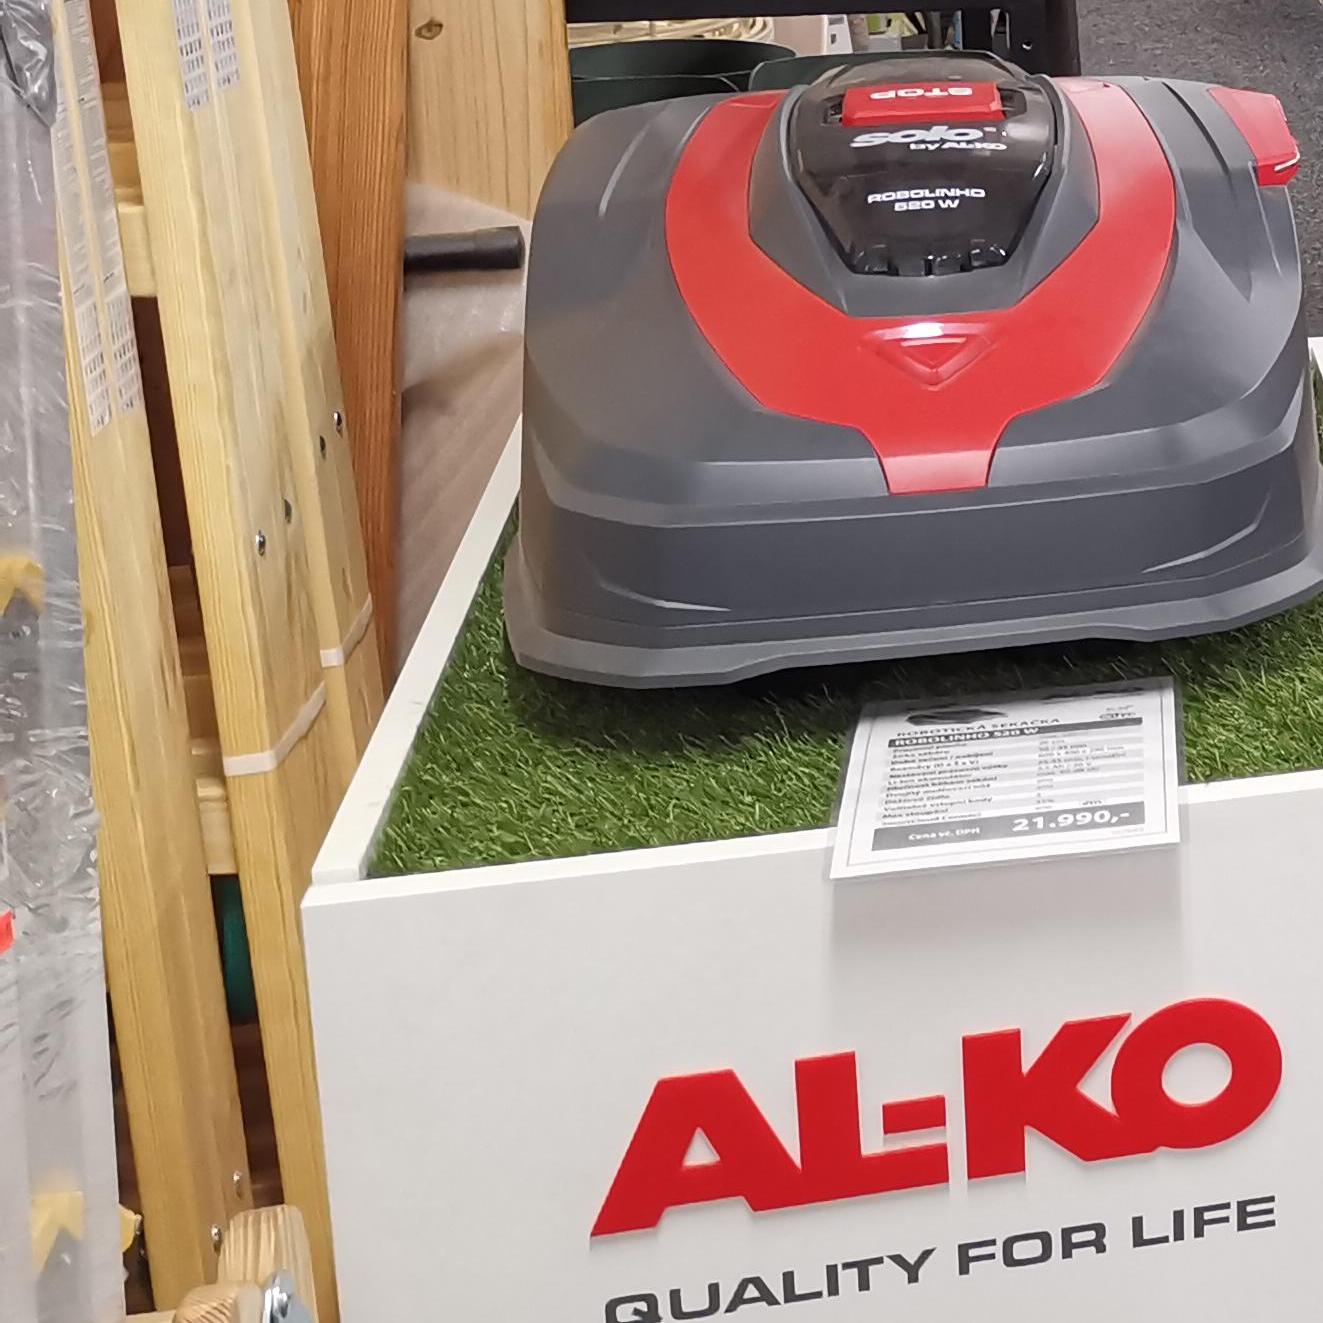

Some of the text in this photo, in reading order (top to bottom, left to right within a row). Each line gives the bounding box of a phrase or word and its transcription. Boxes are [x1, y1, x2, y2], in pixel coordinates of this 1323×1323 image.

[870, 86, 973, 100] STOP
[850, 125, 984, 148] solo
[910, 141, 941, 151] by
[867, 187, 986, 204] ROBOLINHO
[938, 199, 960, 209] W
[895, 731, 990, 746] ROBOLINHO
[1012, 809, 1131, 832] 21.990,-
[589, 997, 1283, 1238] AL-KO
[605, 1195, 1277, 1323] QUALITY FOR LIFE
